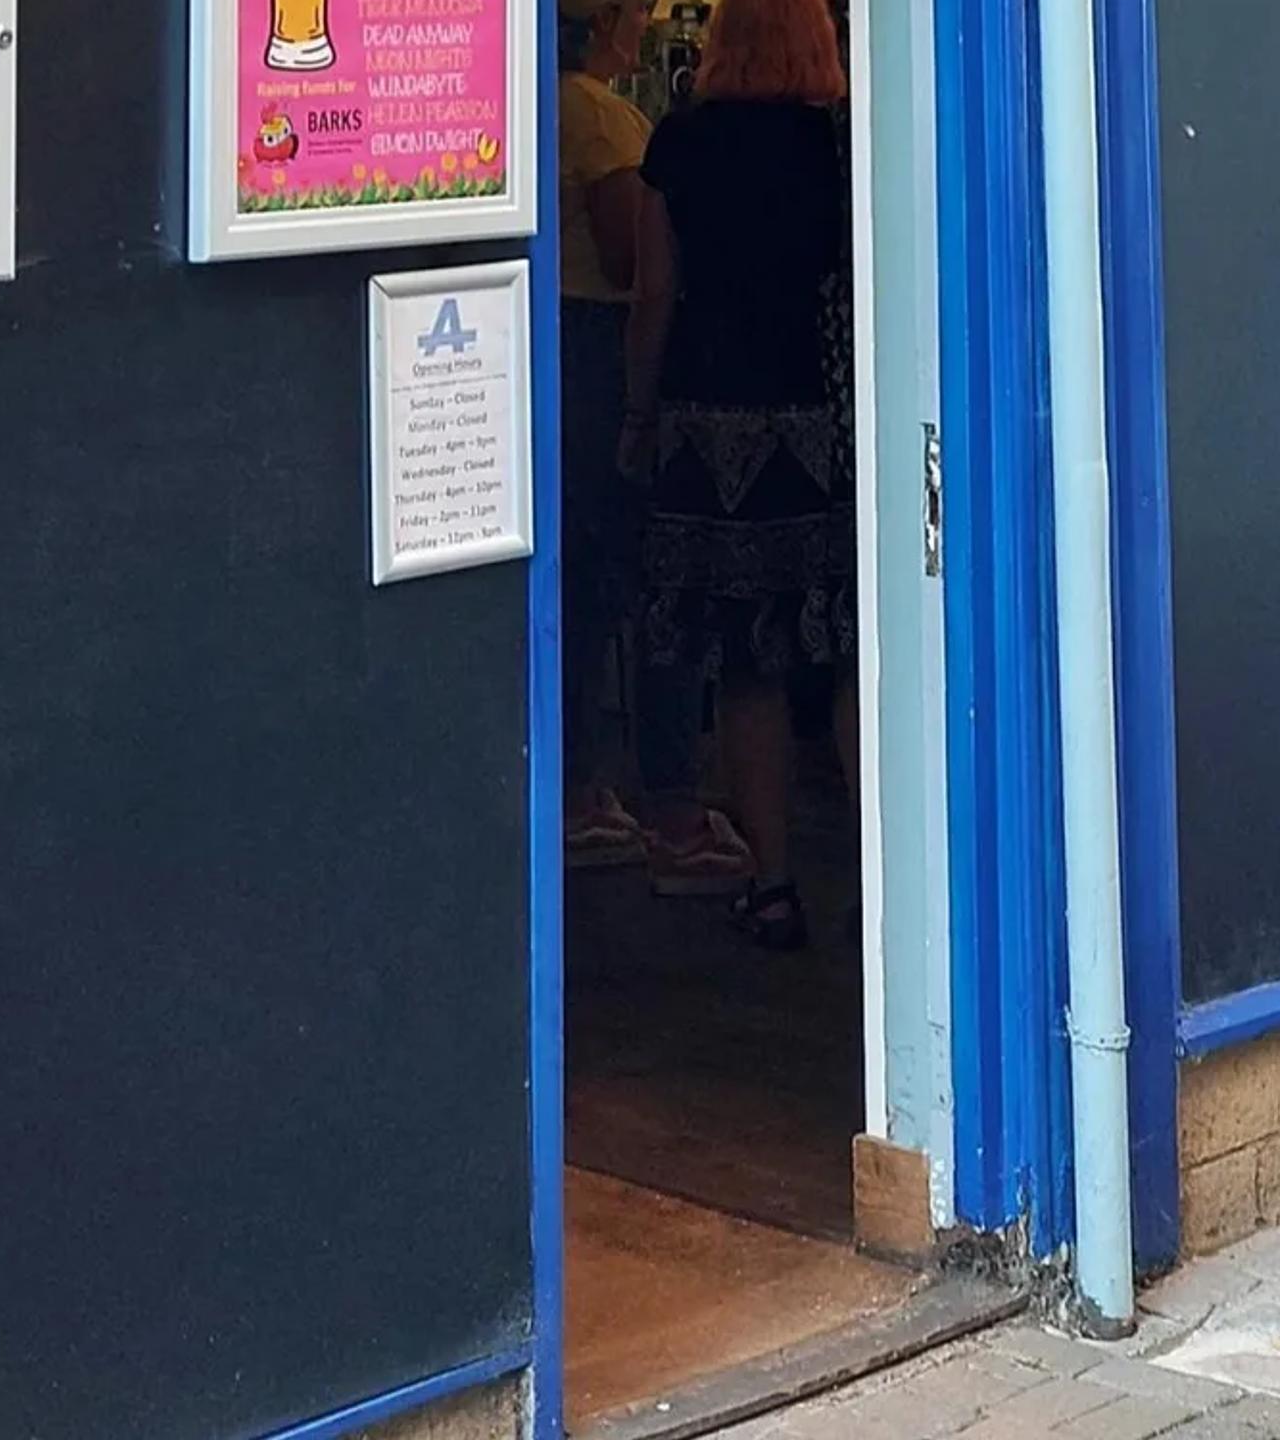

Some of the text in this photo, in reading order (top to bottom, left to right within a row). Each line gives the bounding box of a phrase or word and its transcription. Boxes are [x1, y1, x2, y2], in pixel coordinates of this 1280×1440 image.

[363, 24, 404, 47] DEAD
[307, 109, 363, 133] BARKS
[455, 390, 486, 405] Closed
[456, 412, 487, 428] Closed
[464, 457, 495, 472] Closed
